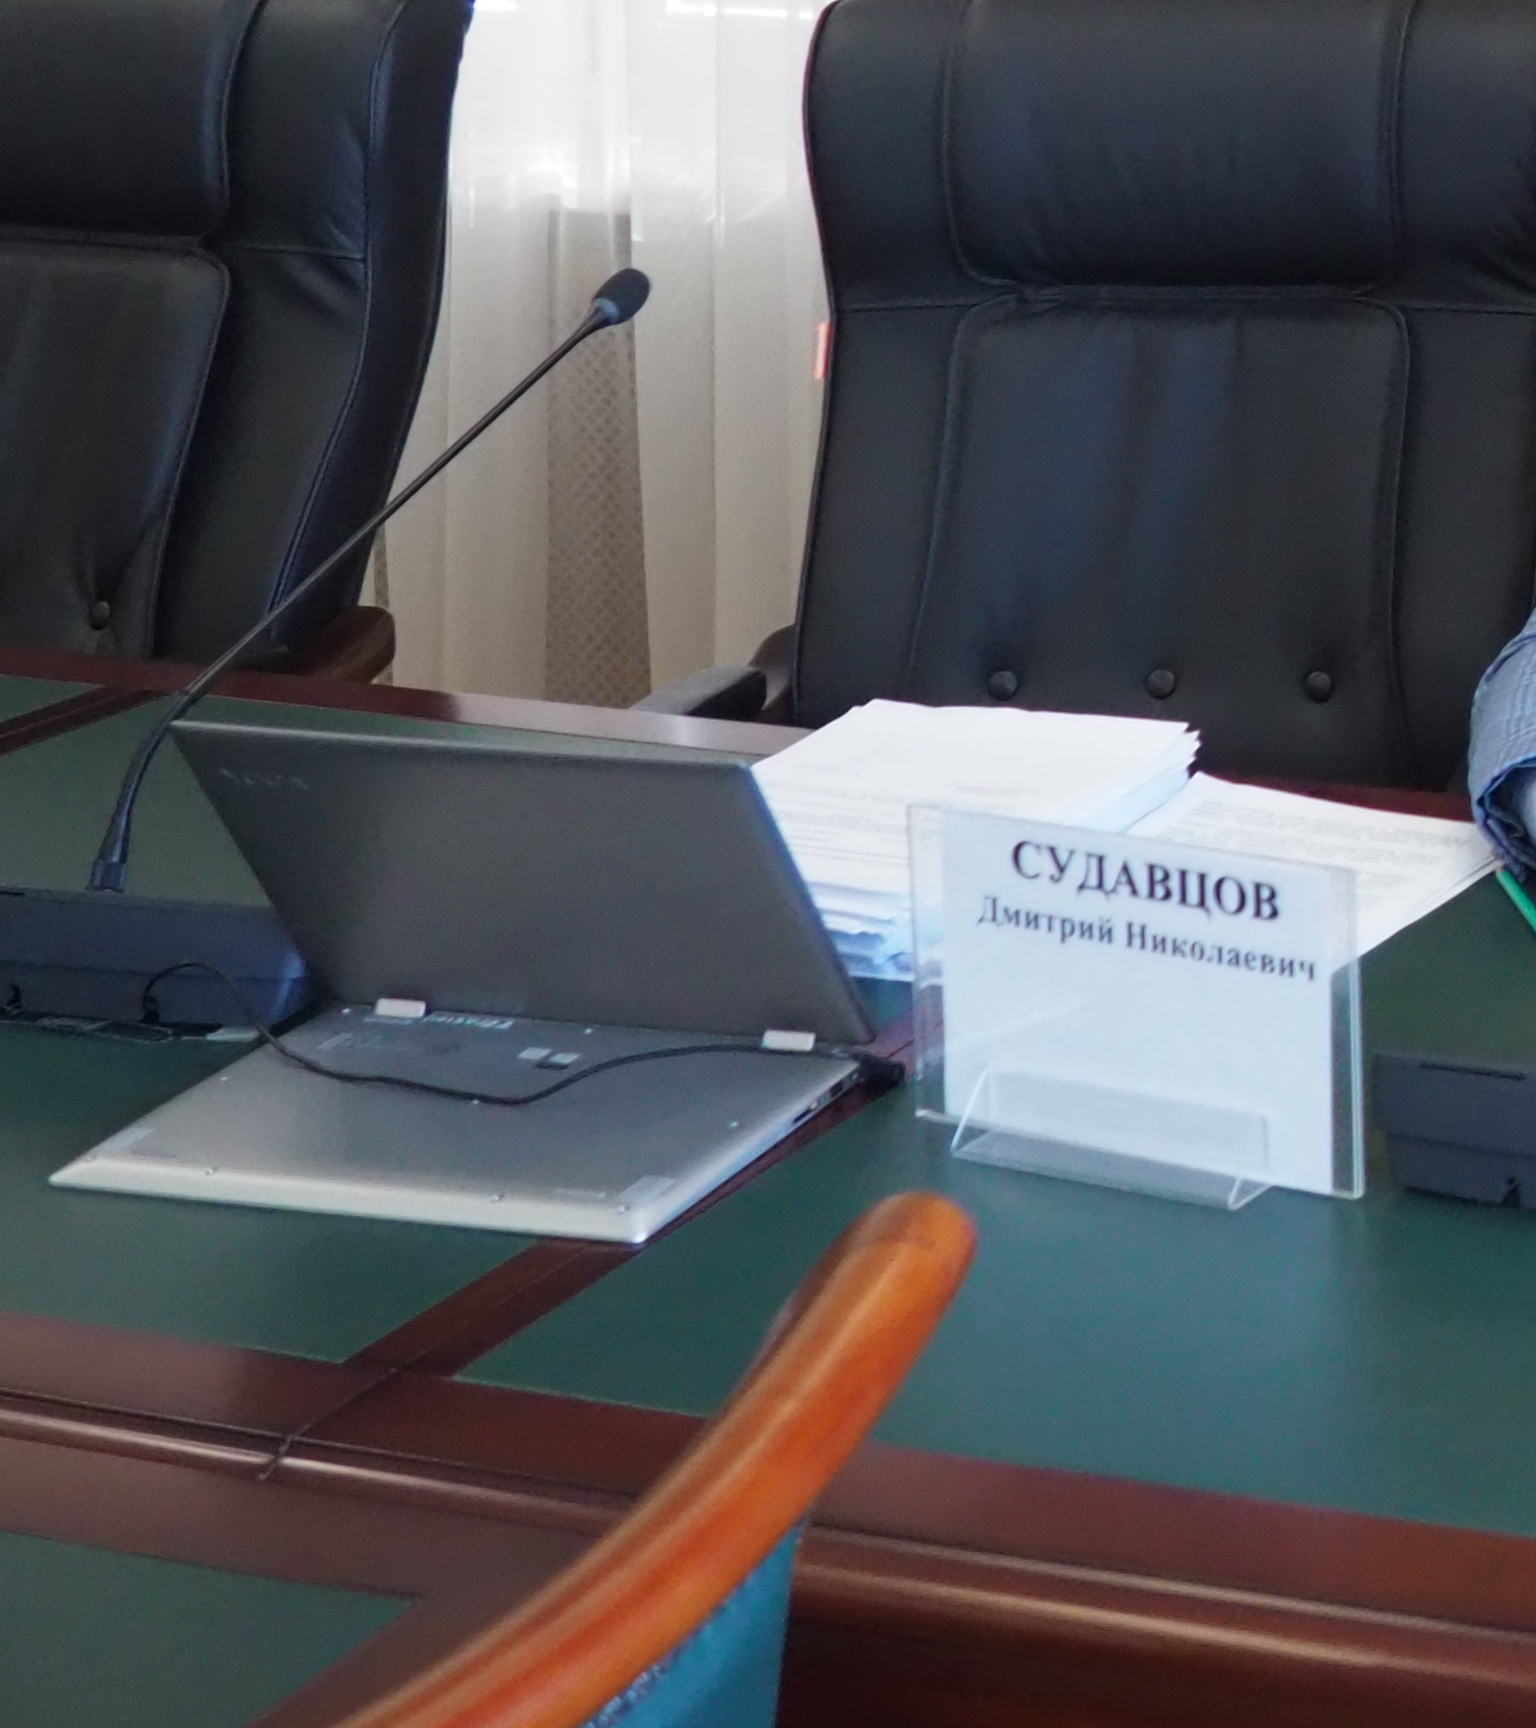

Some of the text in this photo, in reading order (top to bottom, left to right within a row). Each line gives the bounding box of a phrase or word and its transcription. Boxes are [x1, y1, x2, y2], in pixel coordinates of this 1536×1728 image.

[1010, 839, 1280, 922] СУДАВЦОВ
[977, 894, 1317, 981] Дмитрий Николаевич
